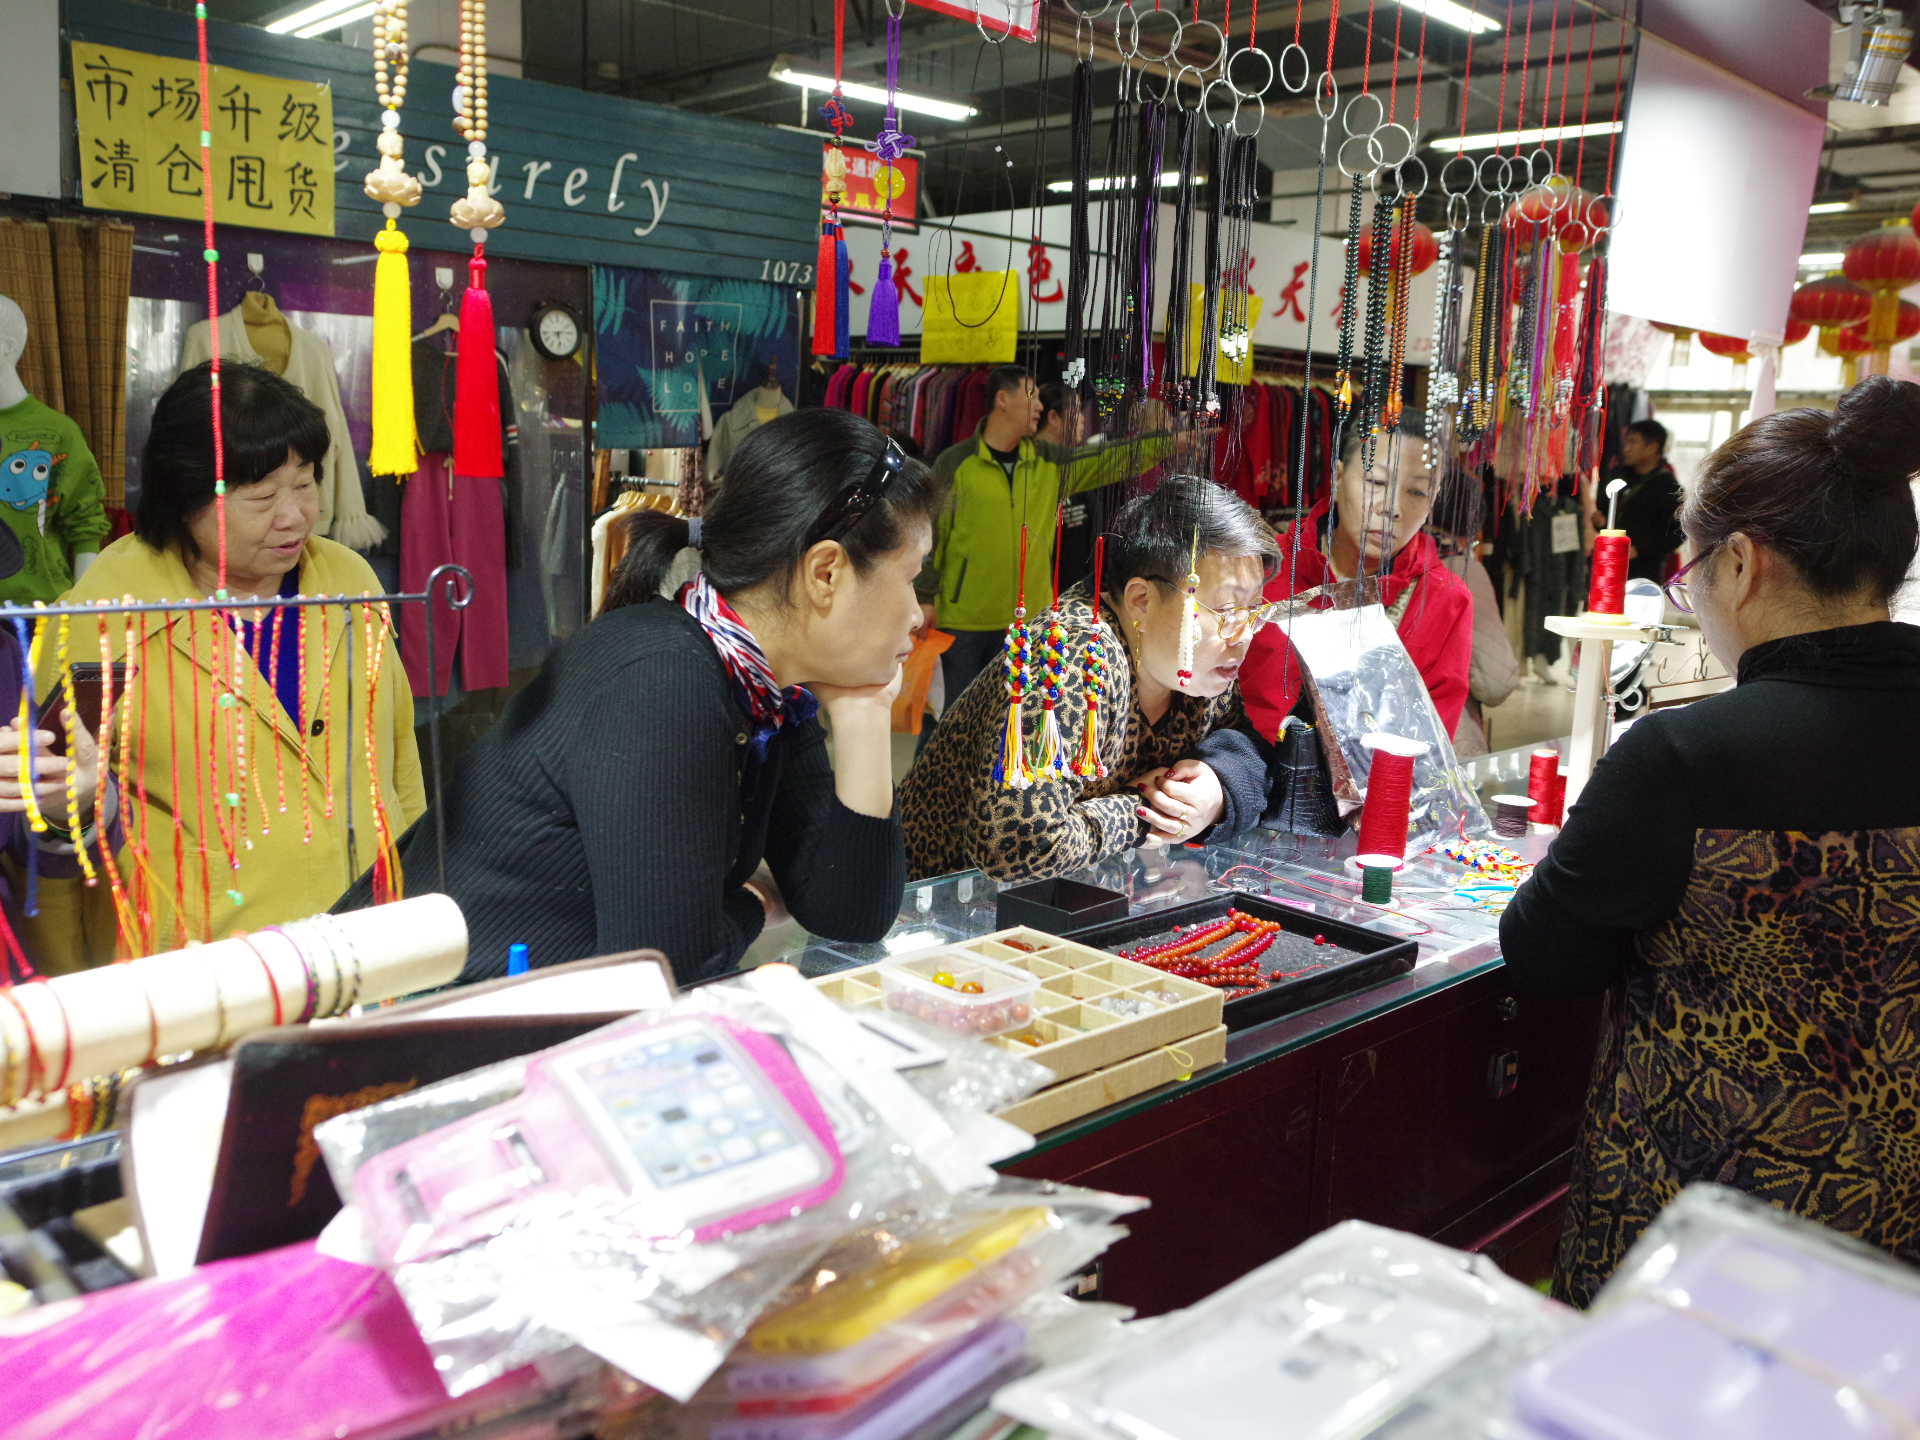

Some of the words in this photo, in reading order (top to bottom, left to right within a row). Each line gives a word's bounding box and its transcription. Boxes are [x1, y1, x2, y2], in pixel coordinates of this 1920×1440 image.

[84, 54, 328, 146] 市场升级
[90, 138, 318, 219] 清仓甩货
[760, 259, 813, 284] 1073
[660, 320, 731, 333] FAITH
[665, 348, 729, 363] HOPE
[664, 377, 727, 394] LOE
